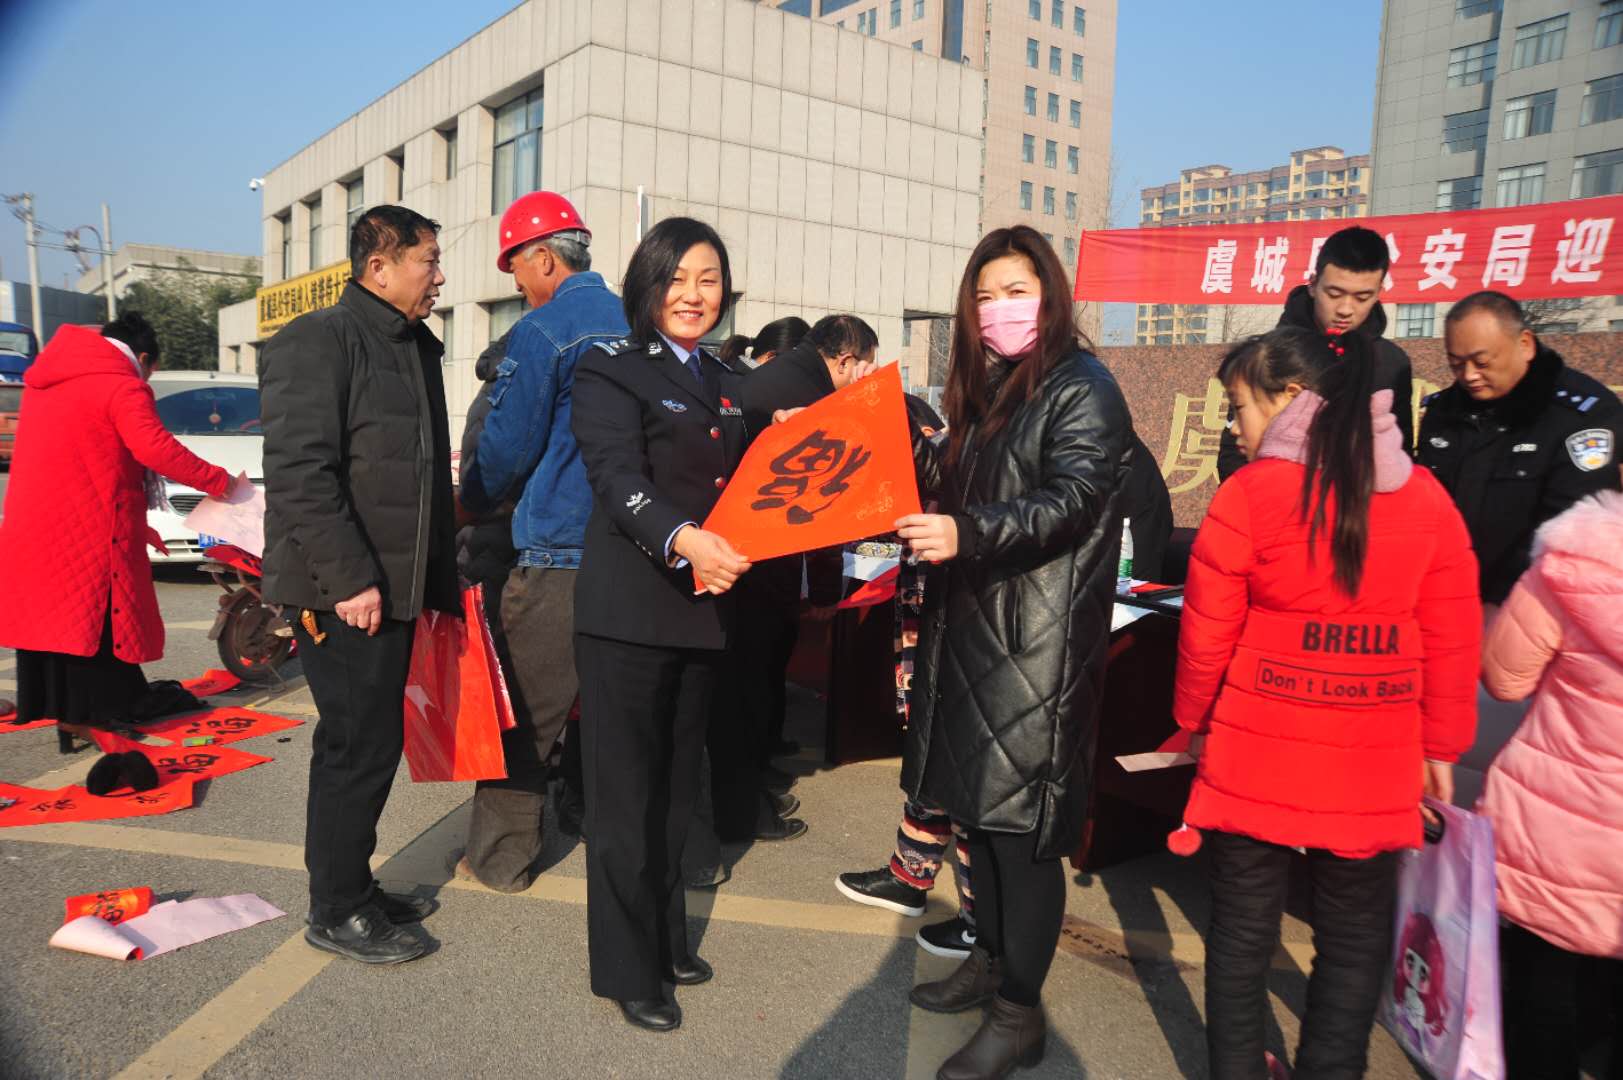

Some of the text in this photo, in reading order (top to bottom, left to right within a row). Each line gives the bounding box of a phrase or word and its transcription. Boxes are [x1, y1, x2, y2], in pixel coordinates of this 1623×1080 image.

[1201, 217, 1615, 294] 虞城安局迎
[1302, 620, 1400, 655] BRELLA
[1322, 679, 1368, 698] Look
